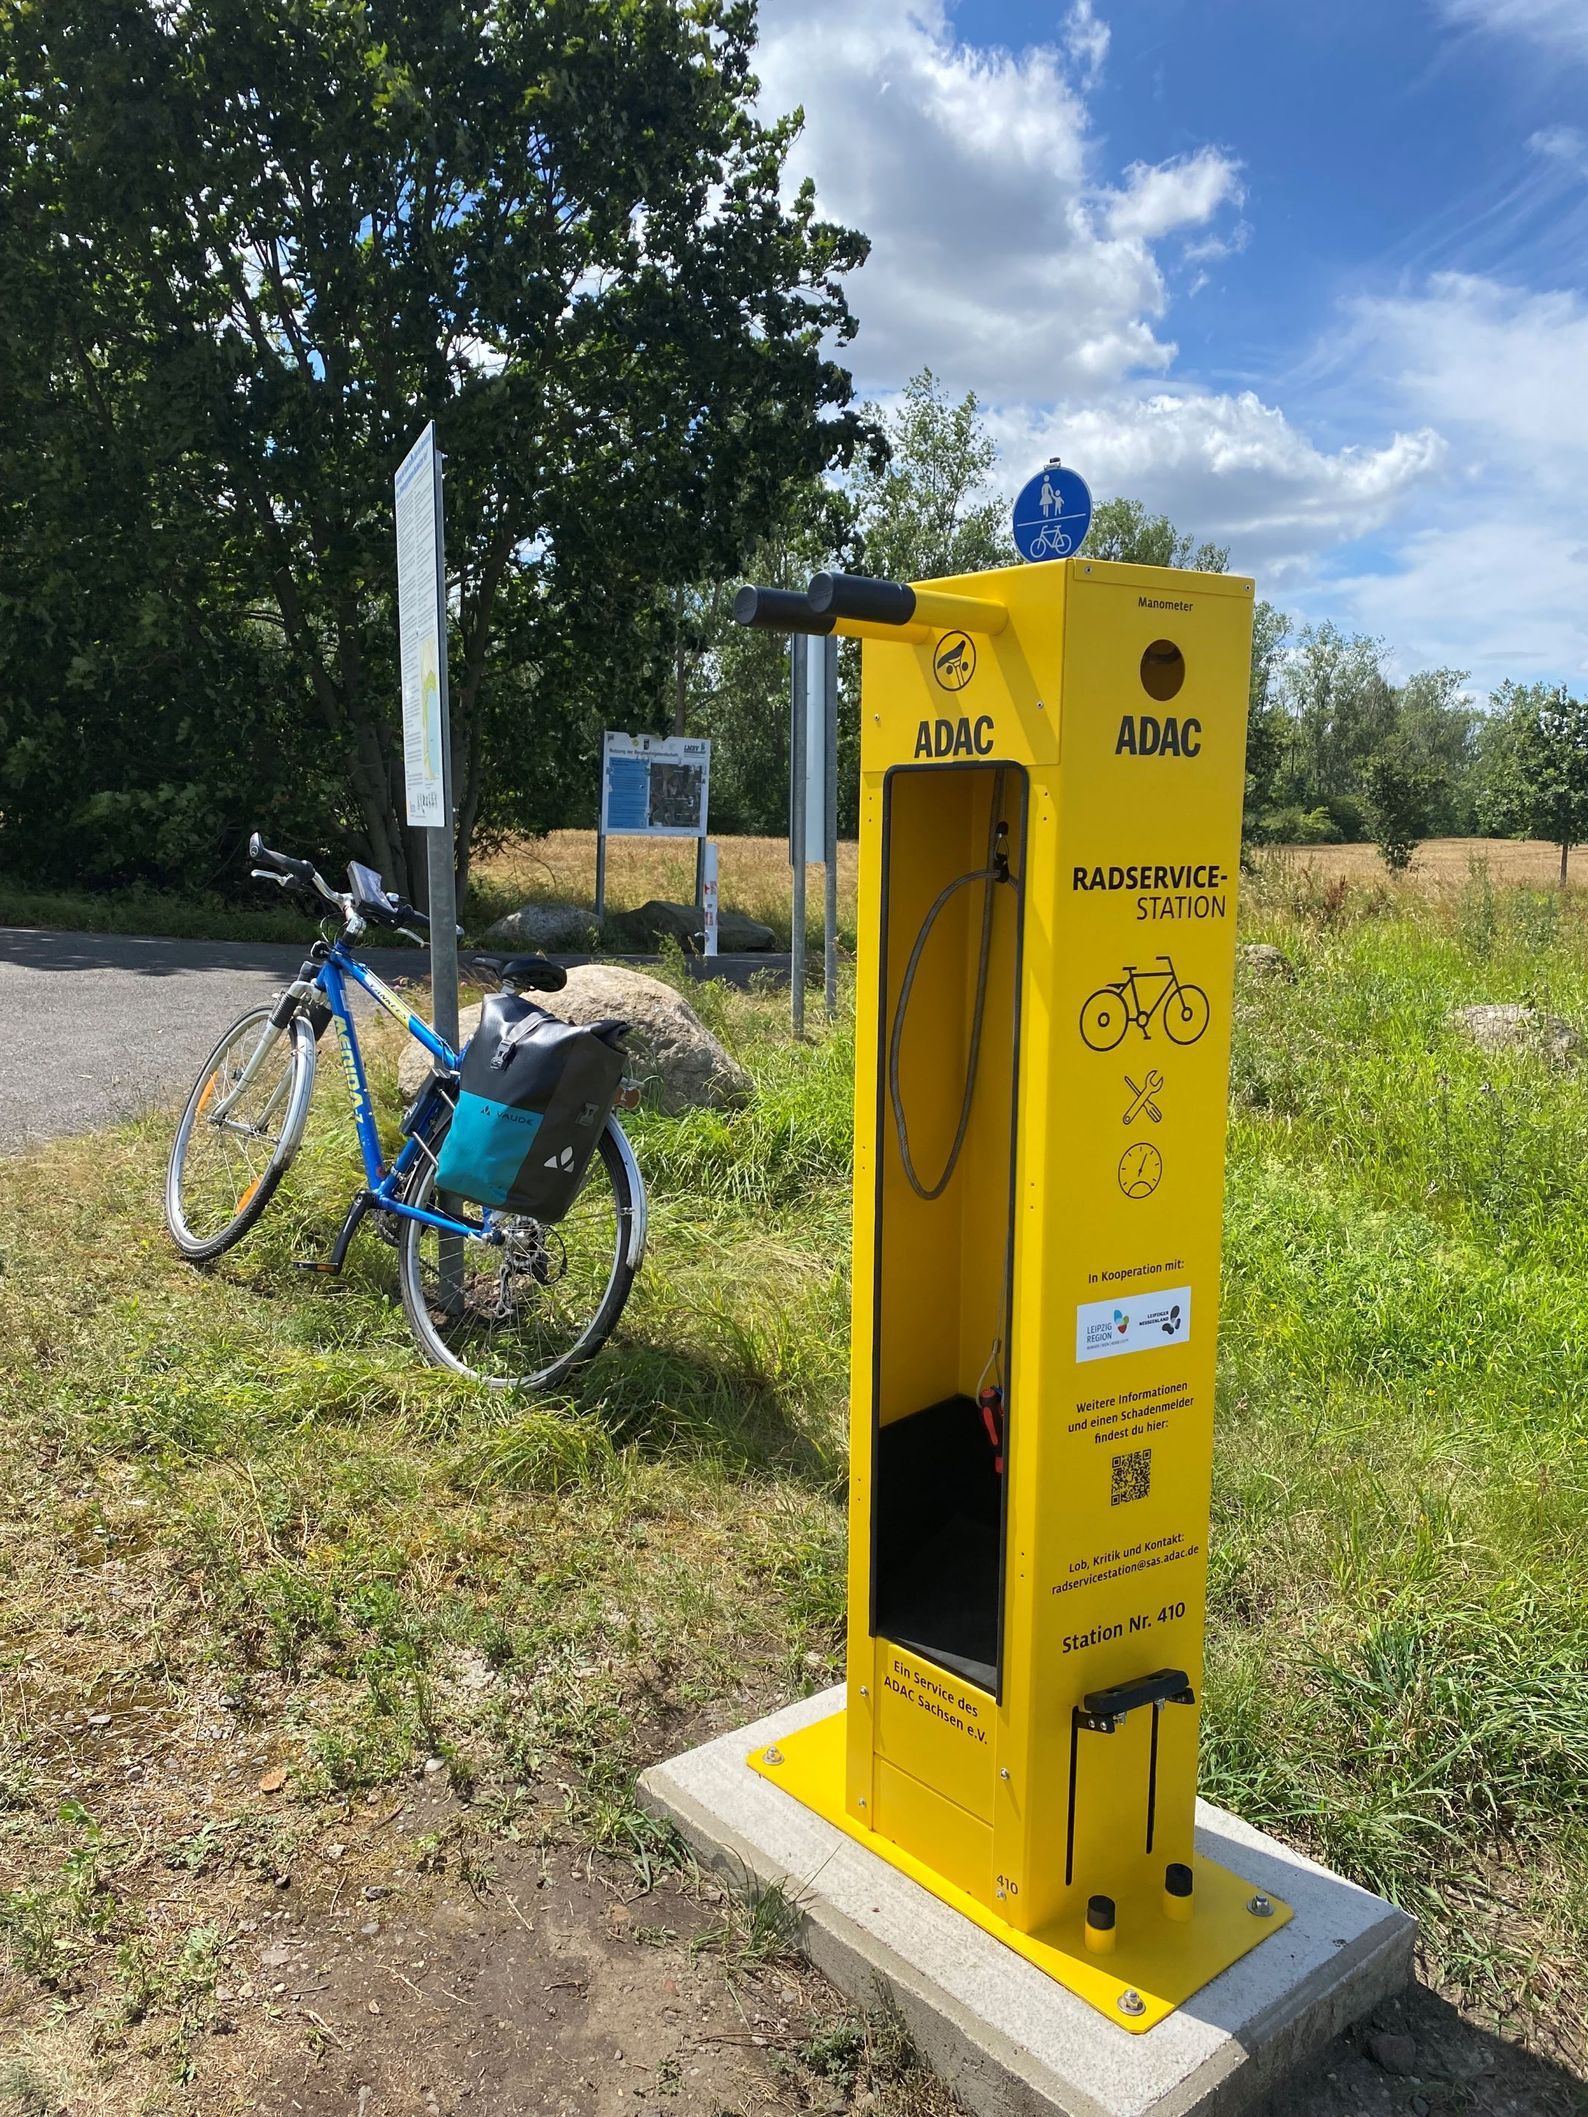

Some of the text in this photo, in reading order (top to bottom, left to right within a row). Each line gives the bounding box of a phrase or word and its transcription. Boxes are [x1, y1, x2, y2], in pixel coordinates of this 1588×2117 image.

[1138, 596, 1194, 612] Manometer
[914, 715, 994, 758] ADAC
[1116, 716, 1202, 758] ADAC
[1073, 865, 1228, 891] RADSERVICE-
[1137, 896, 1226, 920] STATION
[496, 1112, 534, 1126] VAUDE
[1088, 1259, 1184, 1284] In Kooperation mit:
[1087, 1322, 1112, 1334] LEIPZIG
[1087, 1332, 1112, 1343] REGION
[1076, 1382, 1188, 1414] Weitere Informationen
[1068, 1396, 1194, 1432] und einen Schadenmelder
[1094, 1419, 1168, 1444] findest du hier:
[1069, 1533, 1184, 1573] Lob, Kritik und Kontakt:
[1052, 1545, 1199, 1595] radservicestation@sas.adac.de
[1062, 1602, 1186, 1653] Station Nr. 410
[894, 1660, 978, 1718] Ein Service des
[884, 1676, 988, 1745] ADAC Sachsen e.V.
[996, 1874, 1018, 1895] 410
